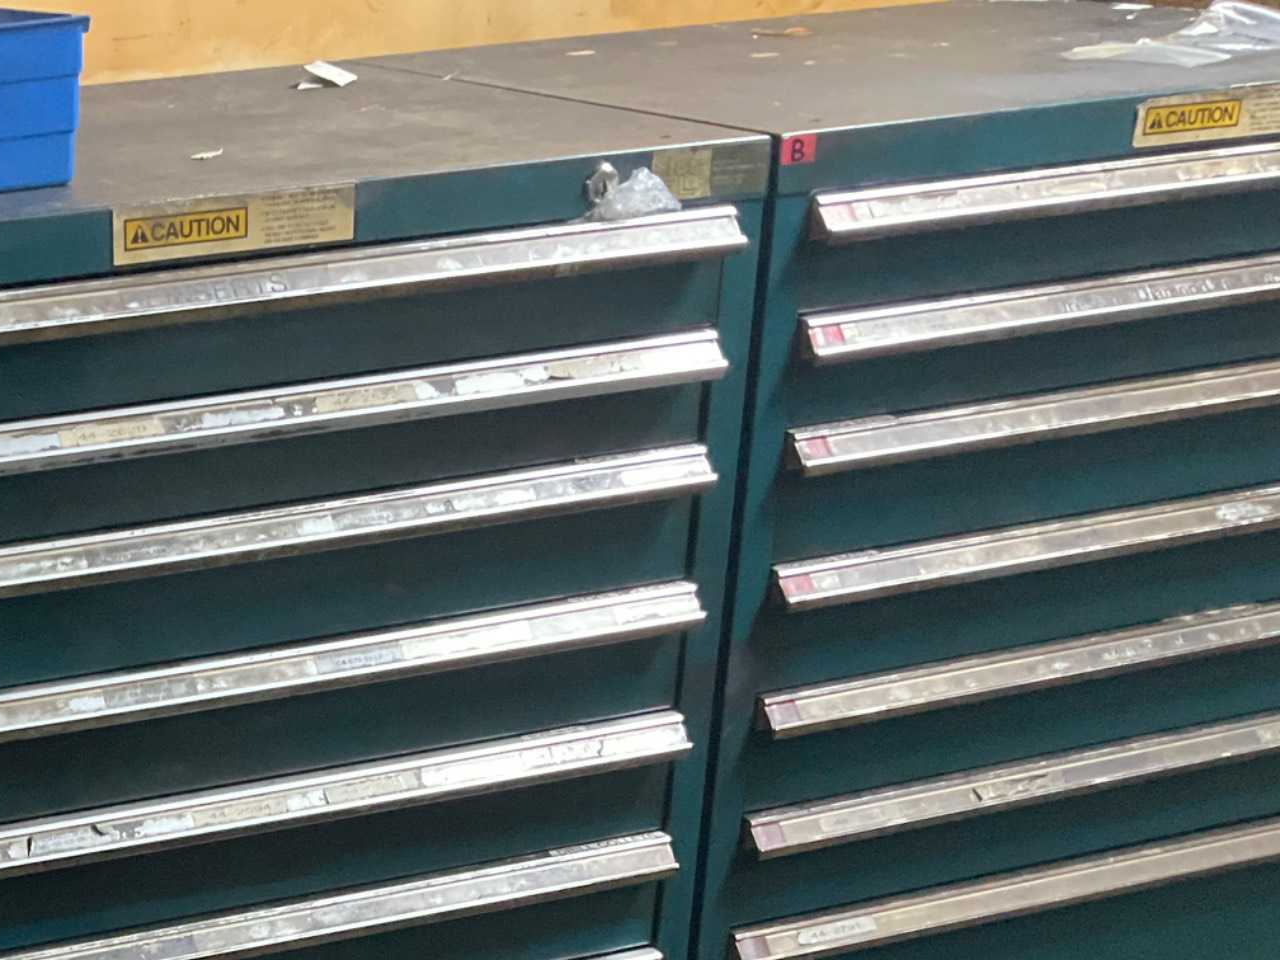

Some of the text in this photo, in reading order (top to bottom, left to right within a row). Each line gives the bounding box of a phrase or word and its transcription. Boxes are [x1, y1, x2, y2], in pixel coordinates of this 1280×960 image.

[1166, 105, 1235, 128] CAUTION
[791, 138, 806, 163] B
[151, 214, 240, 242] CAUTION
